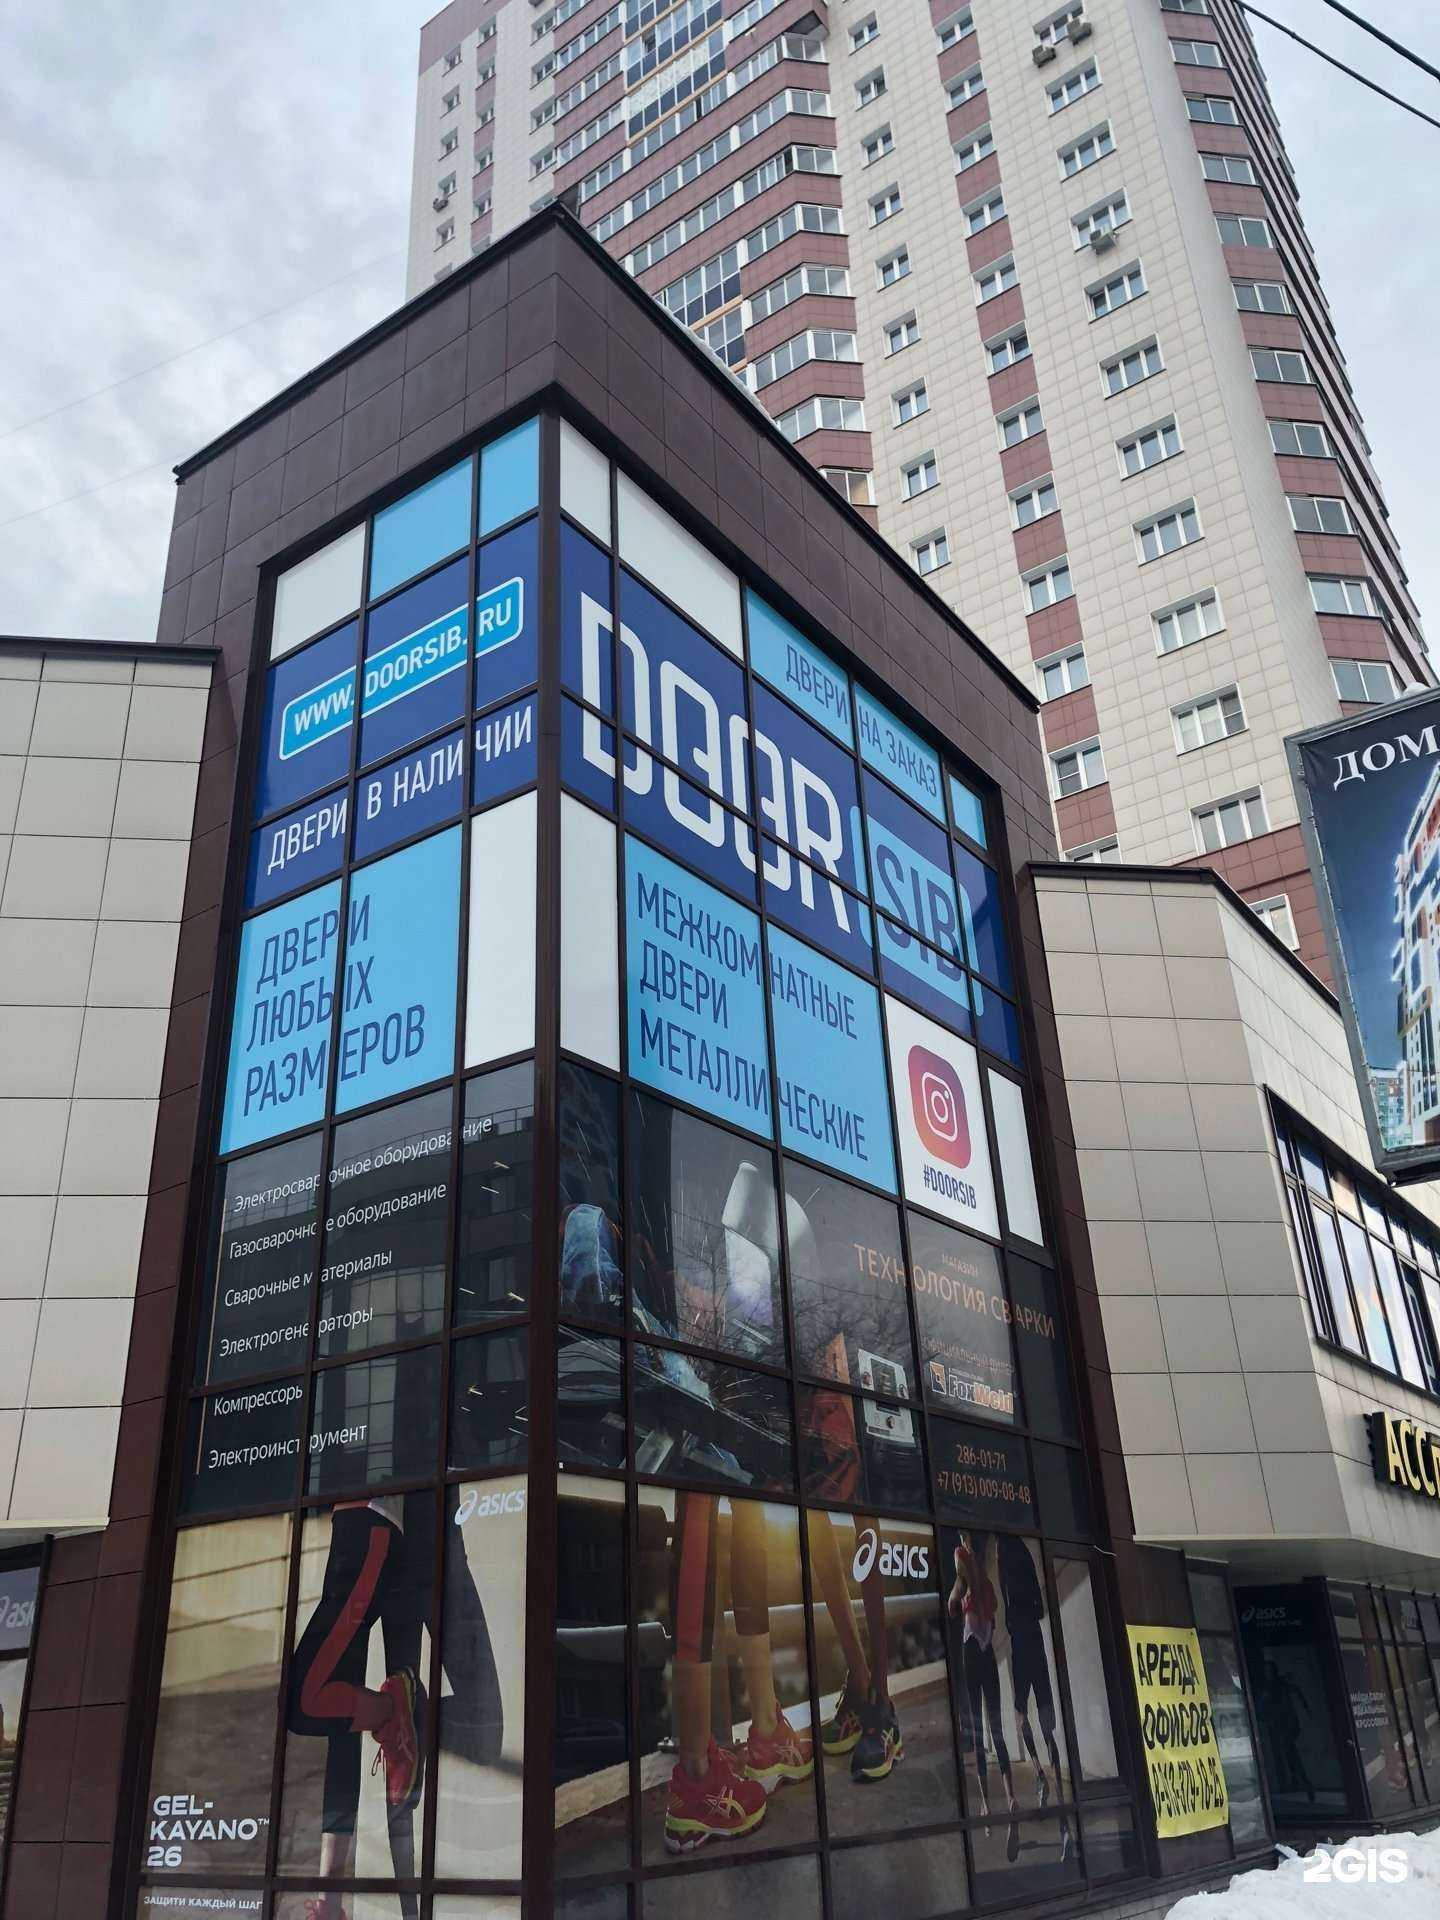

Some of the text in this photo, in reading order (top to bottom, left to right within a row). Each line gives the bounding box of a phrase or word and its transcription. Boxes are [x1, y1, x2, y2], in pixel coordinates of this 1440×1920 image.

[785, 643, 938, 799] ДВЕРИ НА ЗАКАЗ
[267, 704, 532, 876] ДВЕРИ В НАЛИЧИИ
[256, 894, 371, 994] ДВЕРИ
[636, 872, 858, 1041] МЕЖКОМНАТНЫЕ
[246, 955, 375, 1053] ЛЮБЫХ
[640, 939, 729, 1029] ДВЕРИ
[242, 1003, 426, 1117] РАЗМЕРОВ
[640, 1008, 869, 1162] МЕТАЛЛИЧЕСКИЕ
[233, 1117, 493, 1213] Электросварочное оборудование
[923, 1163, 977, 1209] #DOORSIB
[229, 1182, 448, 1260] Газосварочное оборудование
[224, 1250, 392, 1308] Сварочные материалы
[854, 1243, 1056, 1340] ТЕХНОЛОГИЯ СВАРКИ
[219, 1307, 373, 1358] Электрогенераторы
[208, 1423, 368, 1469] Электроинструмент
[955, 1443, 1006, 1473] 286-01-71
[478, 1488, 526, 1516] asics
[937, 1470, 1031, 1505] +7 (913) 009-08-48
[878, 1542, 930, 1580] asics
[1135, 1642, 1200, 1695] АРЕНДА
[1142, 1701, 1211, 1750] ОФИСОВ
[153, 1794, 214, 1817] GEL-
[146, 1845, 183, 1868] 26
[143, 1896, 263, 1910] ЗАЩИТИ КАЖДЫЙ ШАГ
